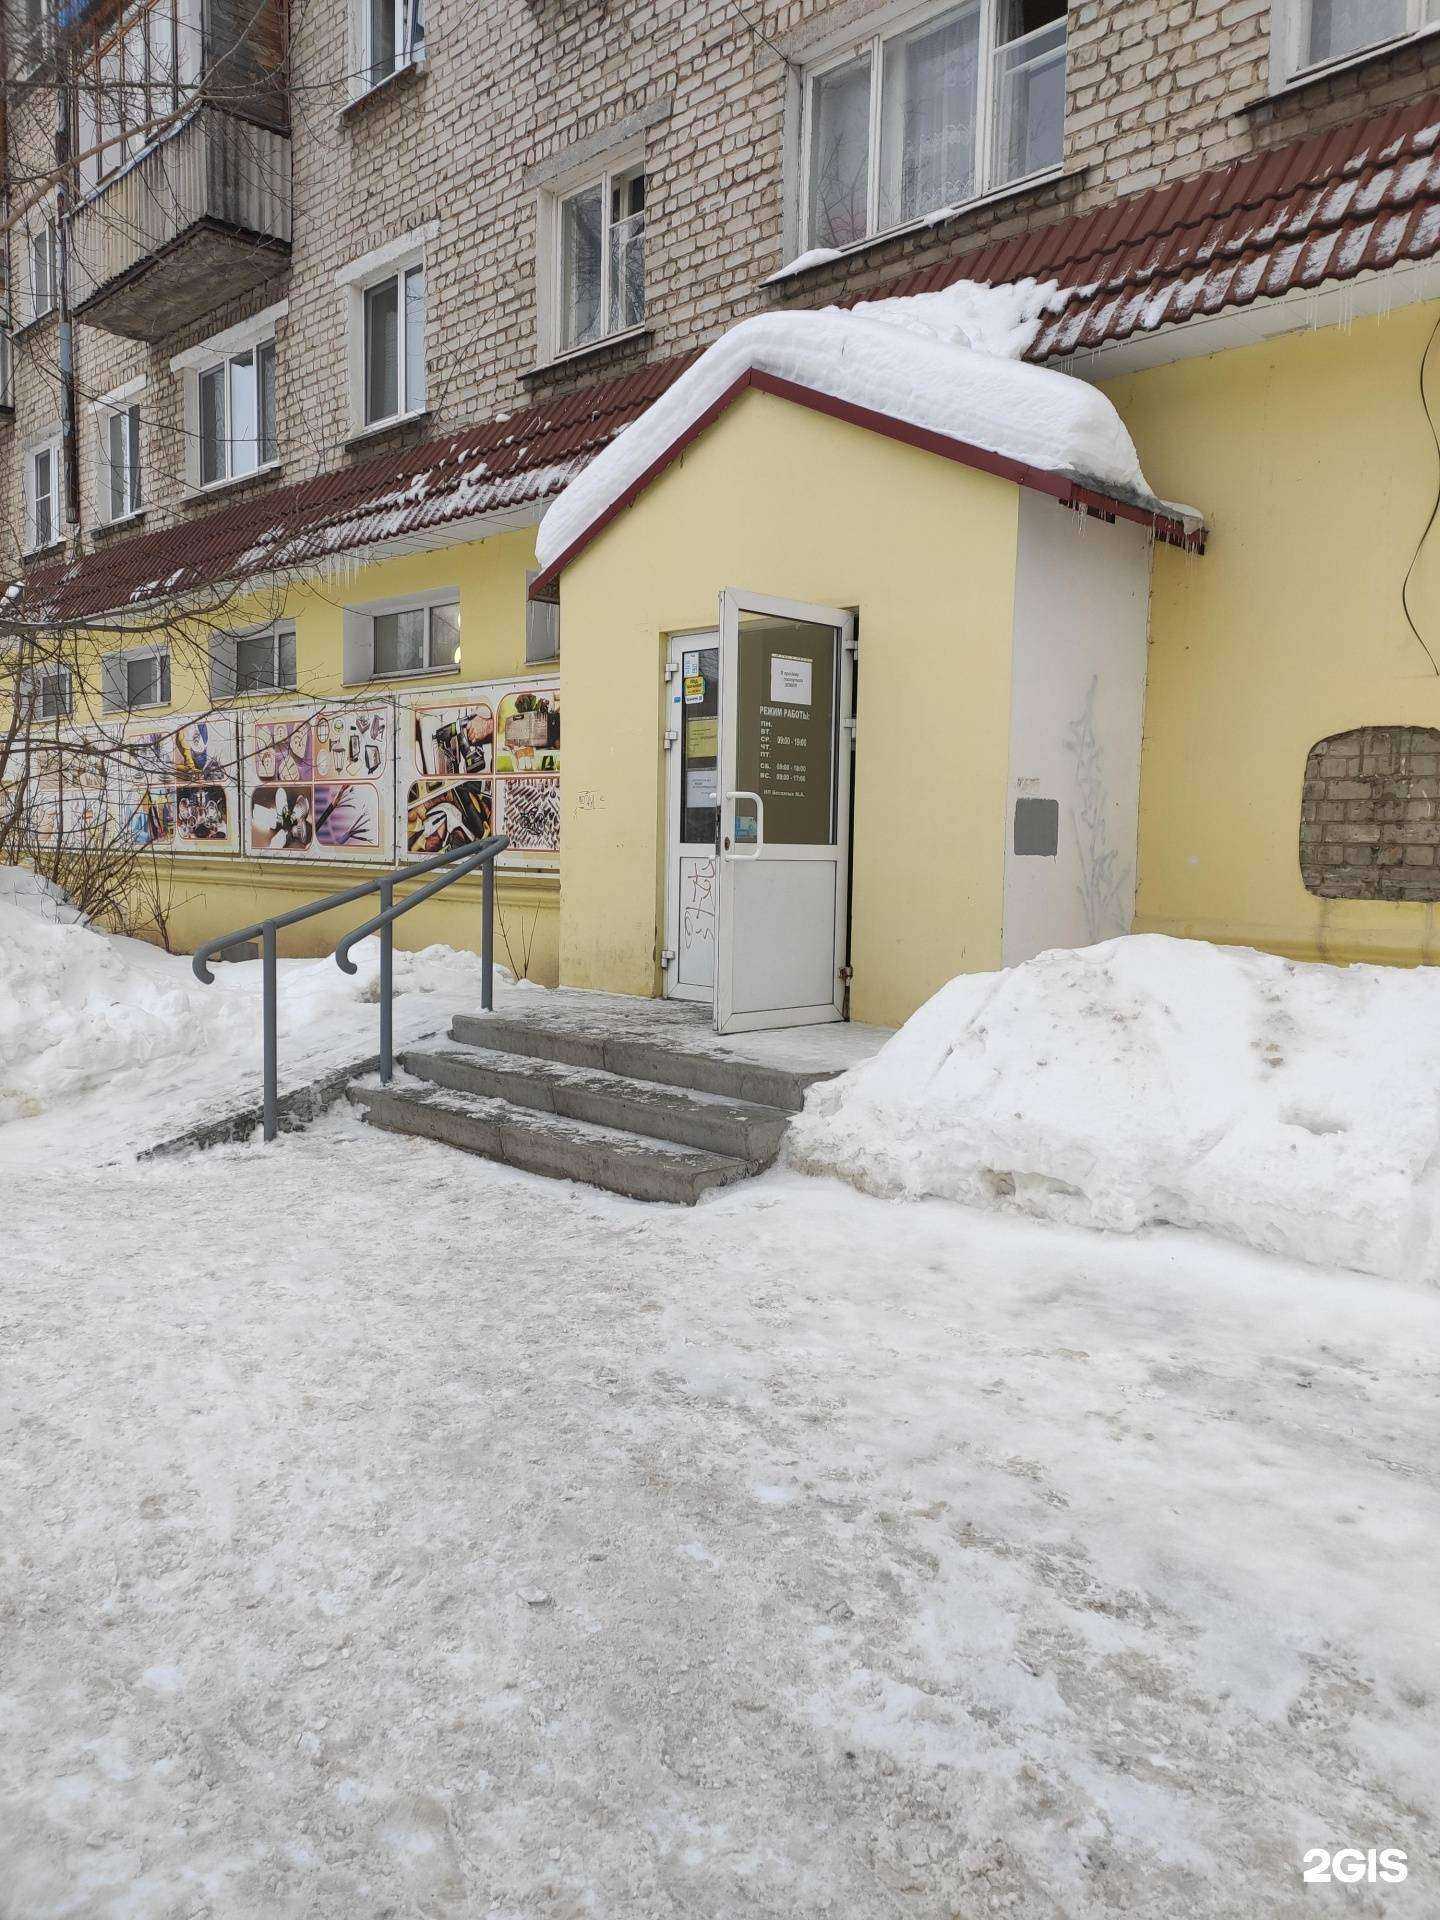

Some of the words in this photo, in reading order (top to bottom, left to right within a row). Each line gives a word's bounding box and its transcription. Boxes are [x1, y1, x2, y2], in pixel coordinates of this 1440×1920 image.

[759, 705, 783, 717] РЕЖИМ
[783, 708, 811, 720] РАБОТЫ:
[760, 720, 773, 728] ПН.
[777, 735, 791, 745] 09:00
